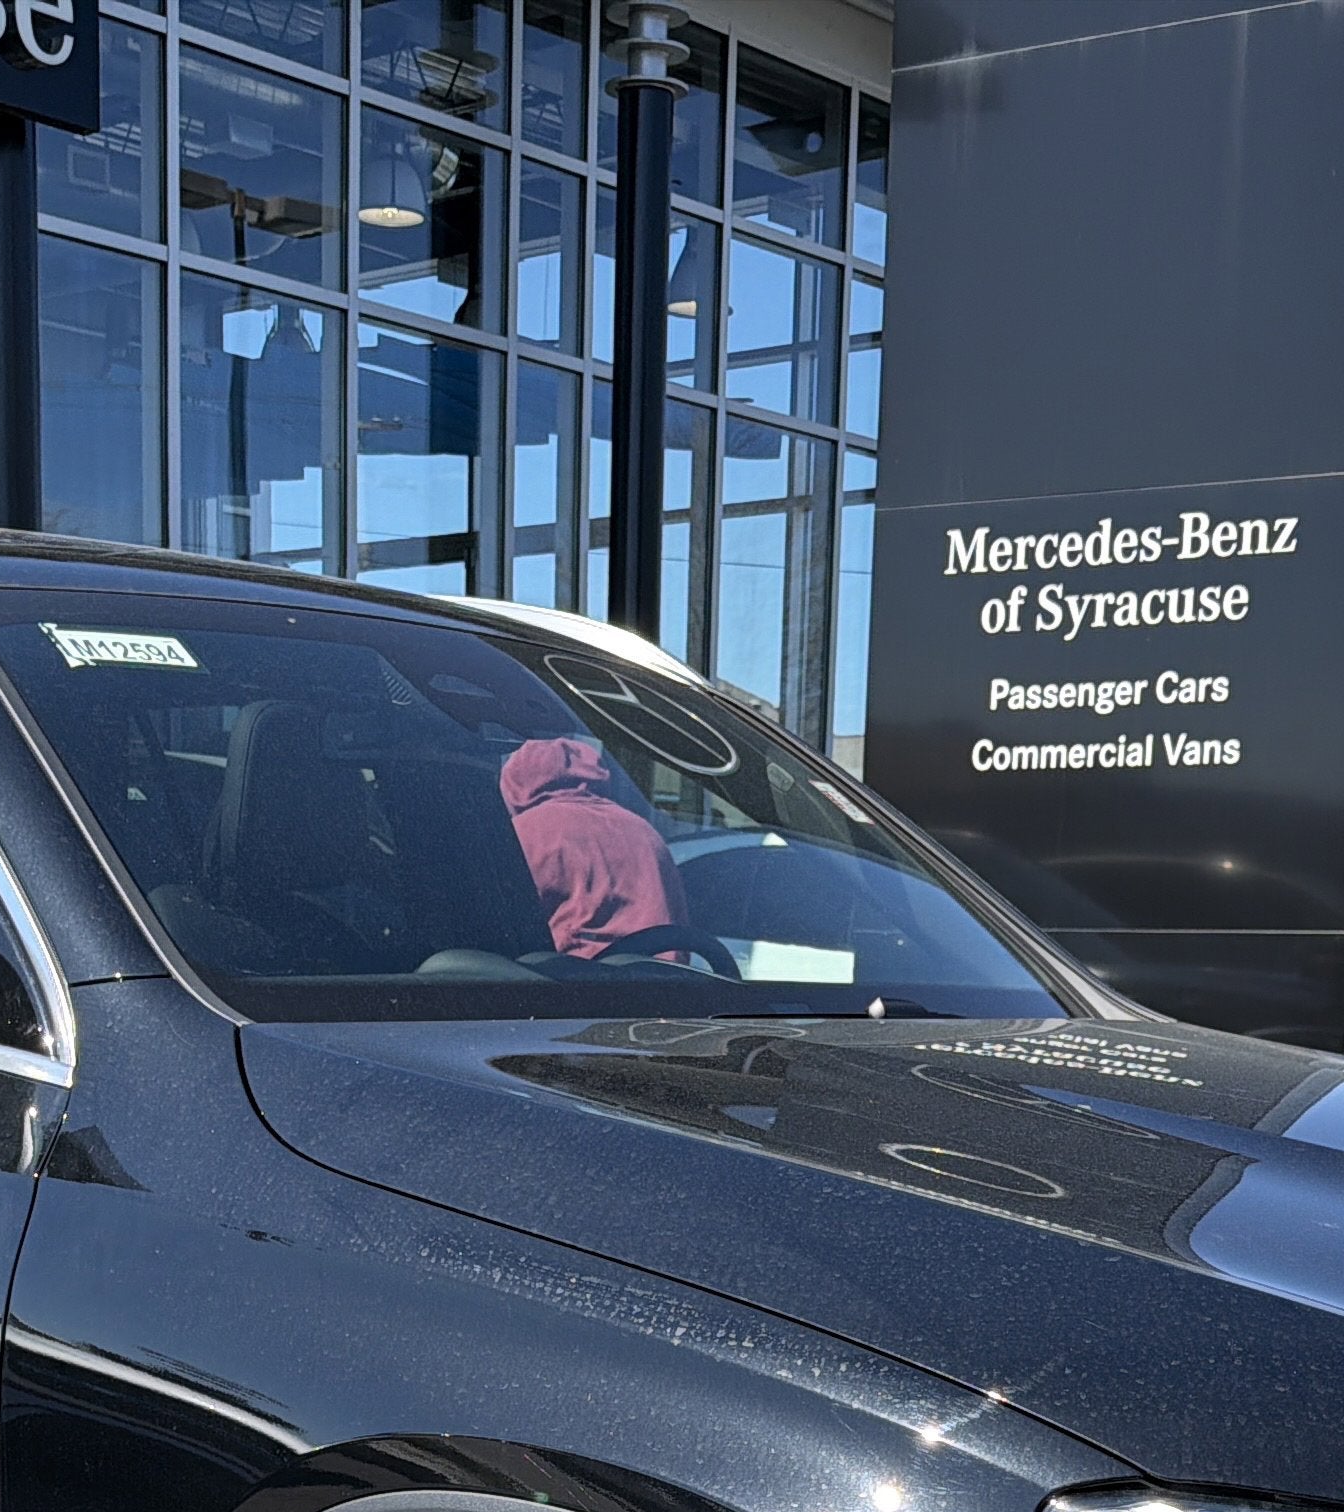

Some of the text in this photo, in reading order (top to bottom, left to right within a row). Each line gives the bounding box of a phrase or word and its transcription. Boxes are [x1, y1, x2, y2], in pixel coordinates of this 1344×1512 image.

[943, 511, 1299, 575] Mercedes-Benz
[981, 583, 1249, 641] of Syracuse
[67, 638, 186, 664] M12594
[989, 670, 1230, 715] Passenger Cars
[971, 732, 1241, 771] Commercial Vans
